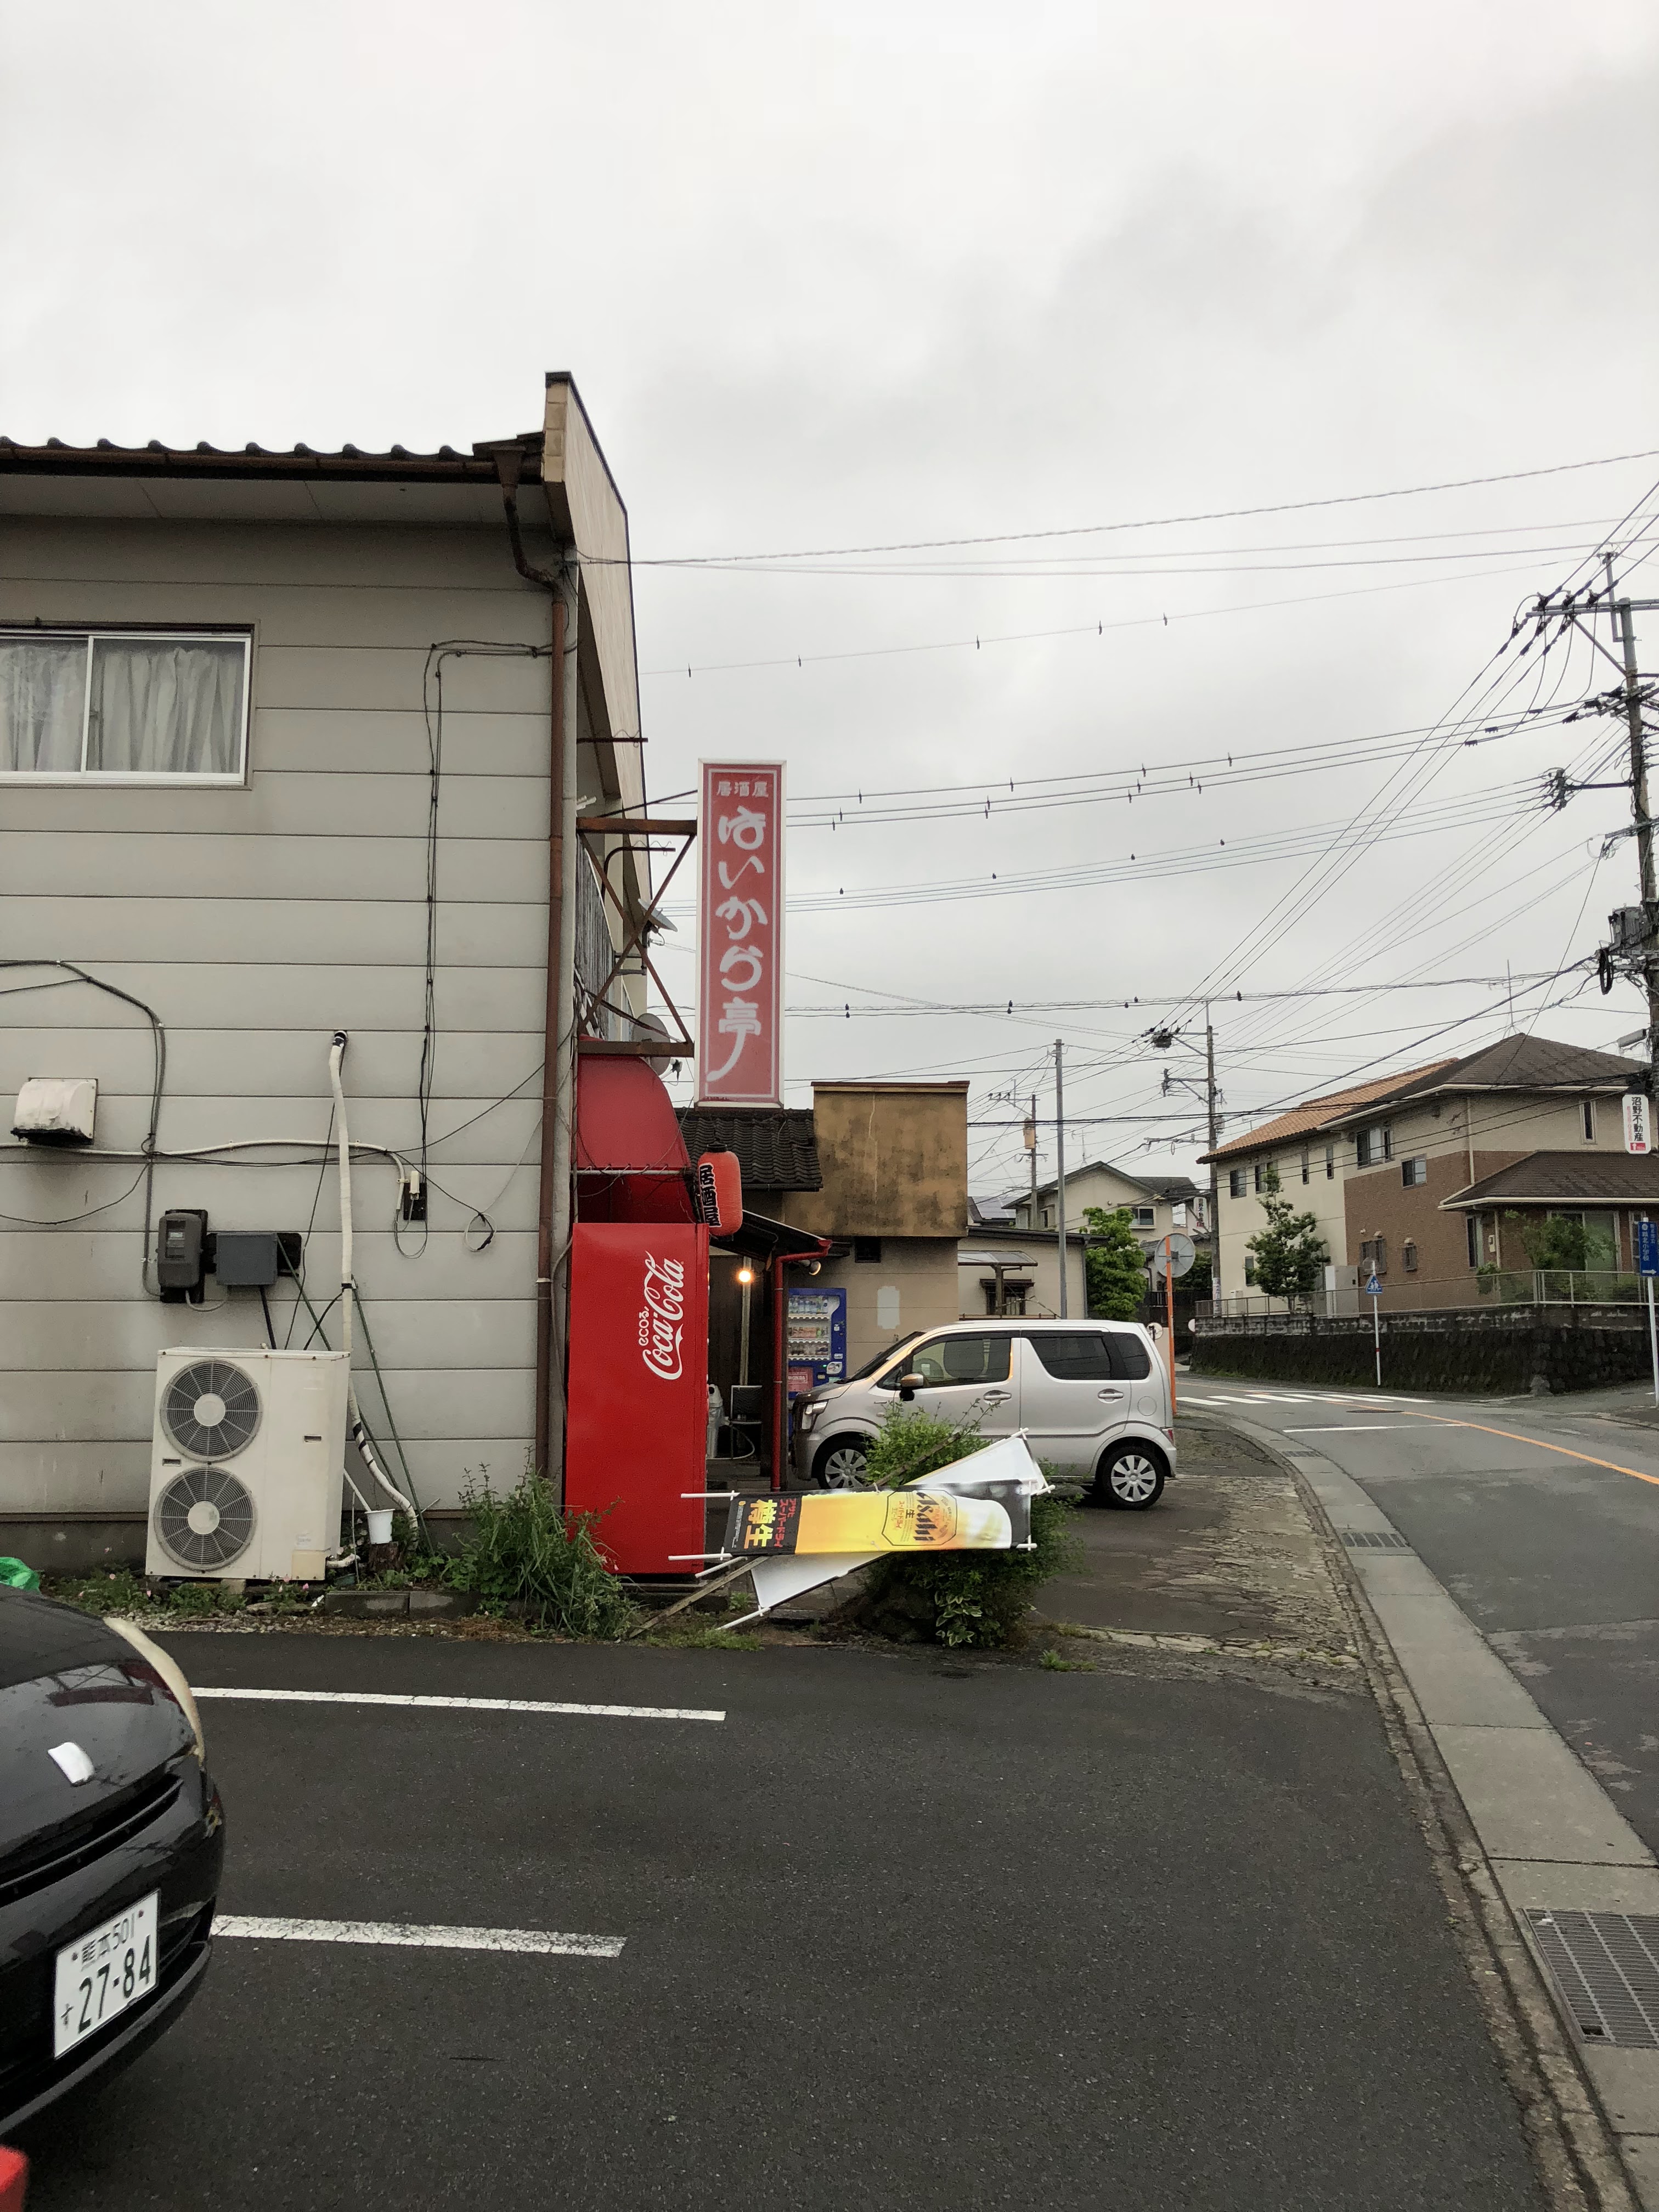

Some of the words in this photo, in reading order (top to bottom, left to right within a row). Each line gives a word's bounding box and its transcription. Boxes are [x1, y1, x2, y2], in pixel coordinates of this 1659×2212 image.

[716, 781, 769, 798] 居酒屋
[706, 805, 768, 1083] はいから亭
[1632, 1096, 1644, 1142] 沼野不動産
[642, 1250, 684, 1380] Coca-Cola
[744, 1499, 778, 1549] 樽生
[774, 1499, 789, 1548] スーパードライ
[788, 1498, 797, 1517] アサヒ
[896, 1501, 905, 1529] スーパードライ
[905, 1509, 915, 1519] 生
[913, 1492, 939, 1542] Asahi
[112, 1913, 136, 1950] 501
[78, 1934, 151, 2034] 27-84
